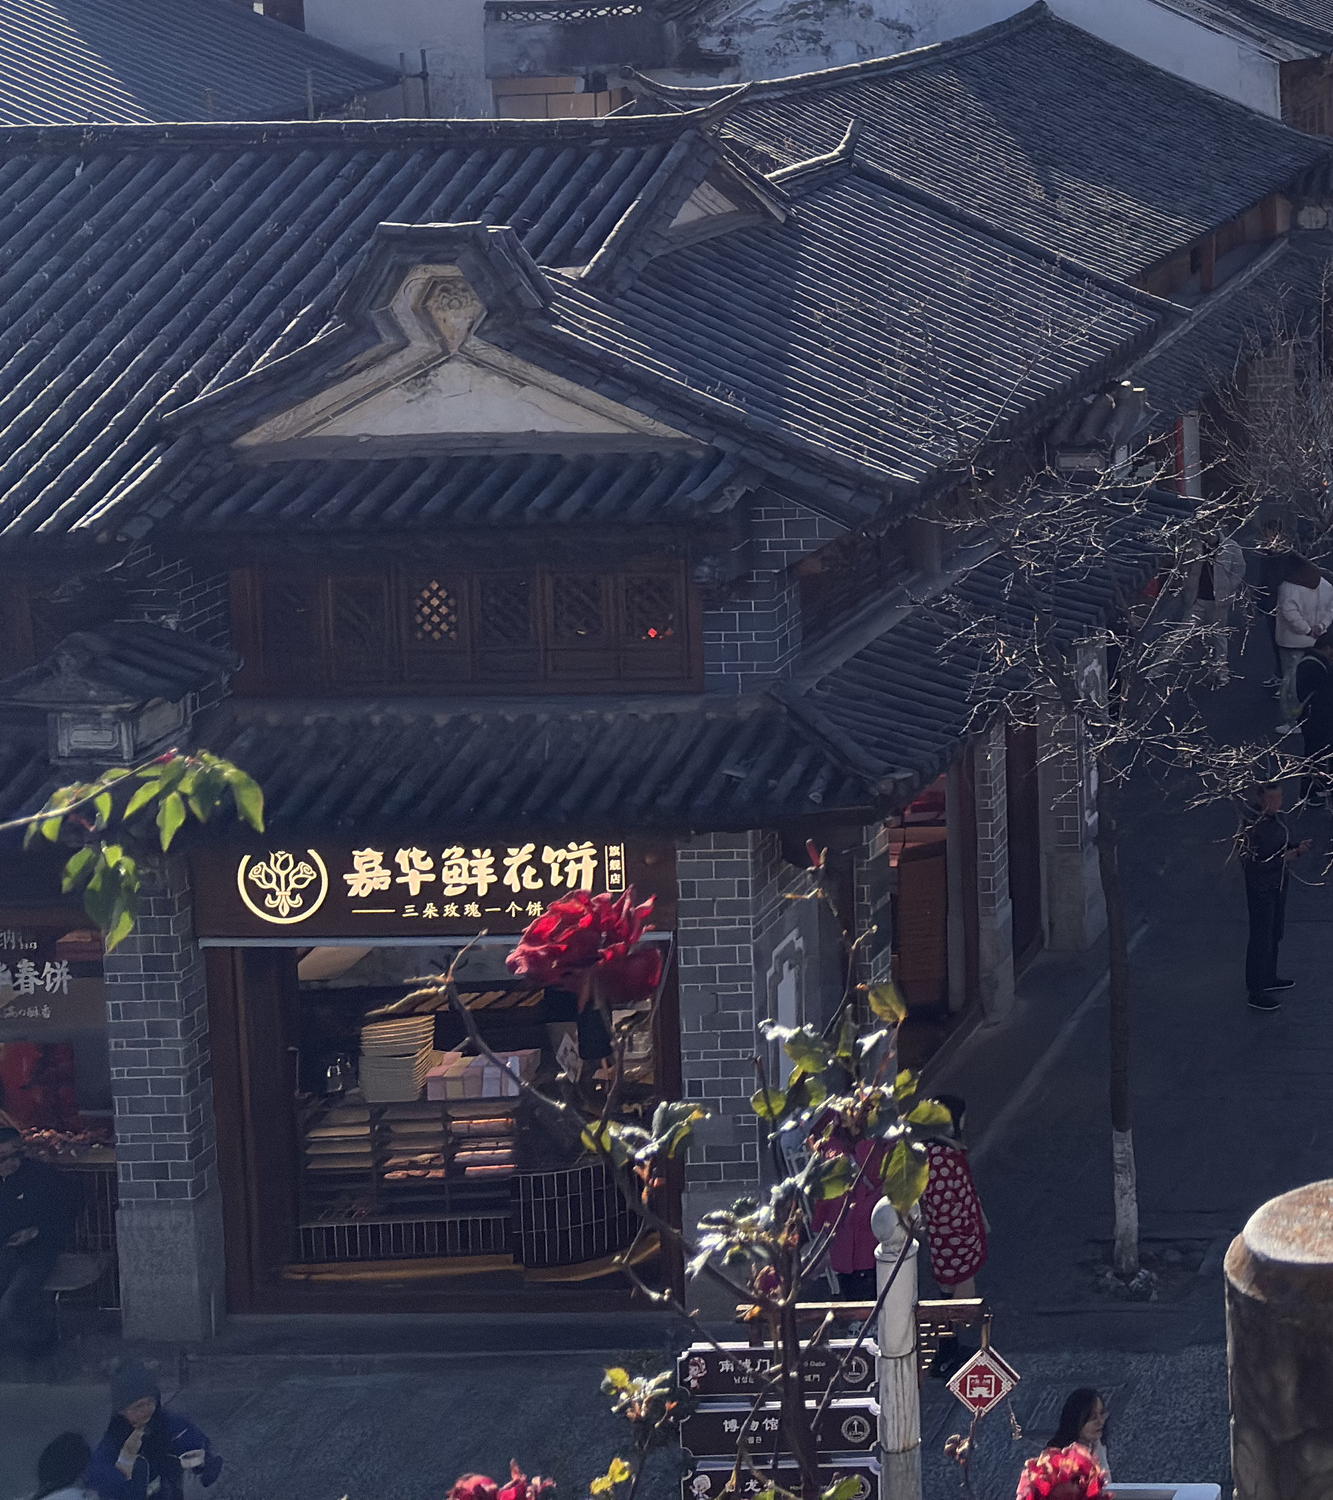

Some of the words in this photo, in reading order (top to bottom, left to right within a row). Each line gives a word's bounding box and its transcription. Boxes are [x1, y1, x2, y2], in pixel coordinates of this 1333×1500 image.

[341, 841, 600, 897] 嘉华鲜花饼
[609, 845, 621, 885] 旗舰店
[402, 901, 544, 918] 三朵玫瑰一个饼
